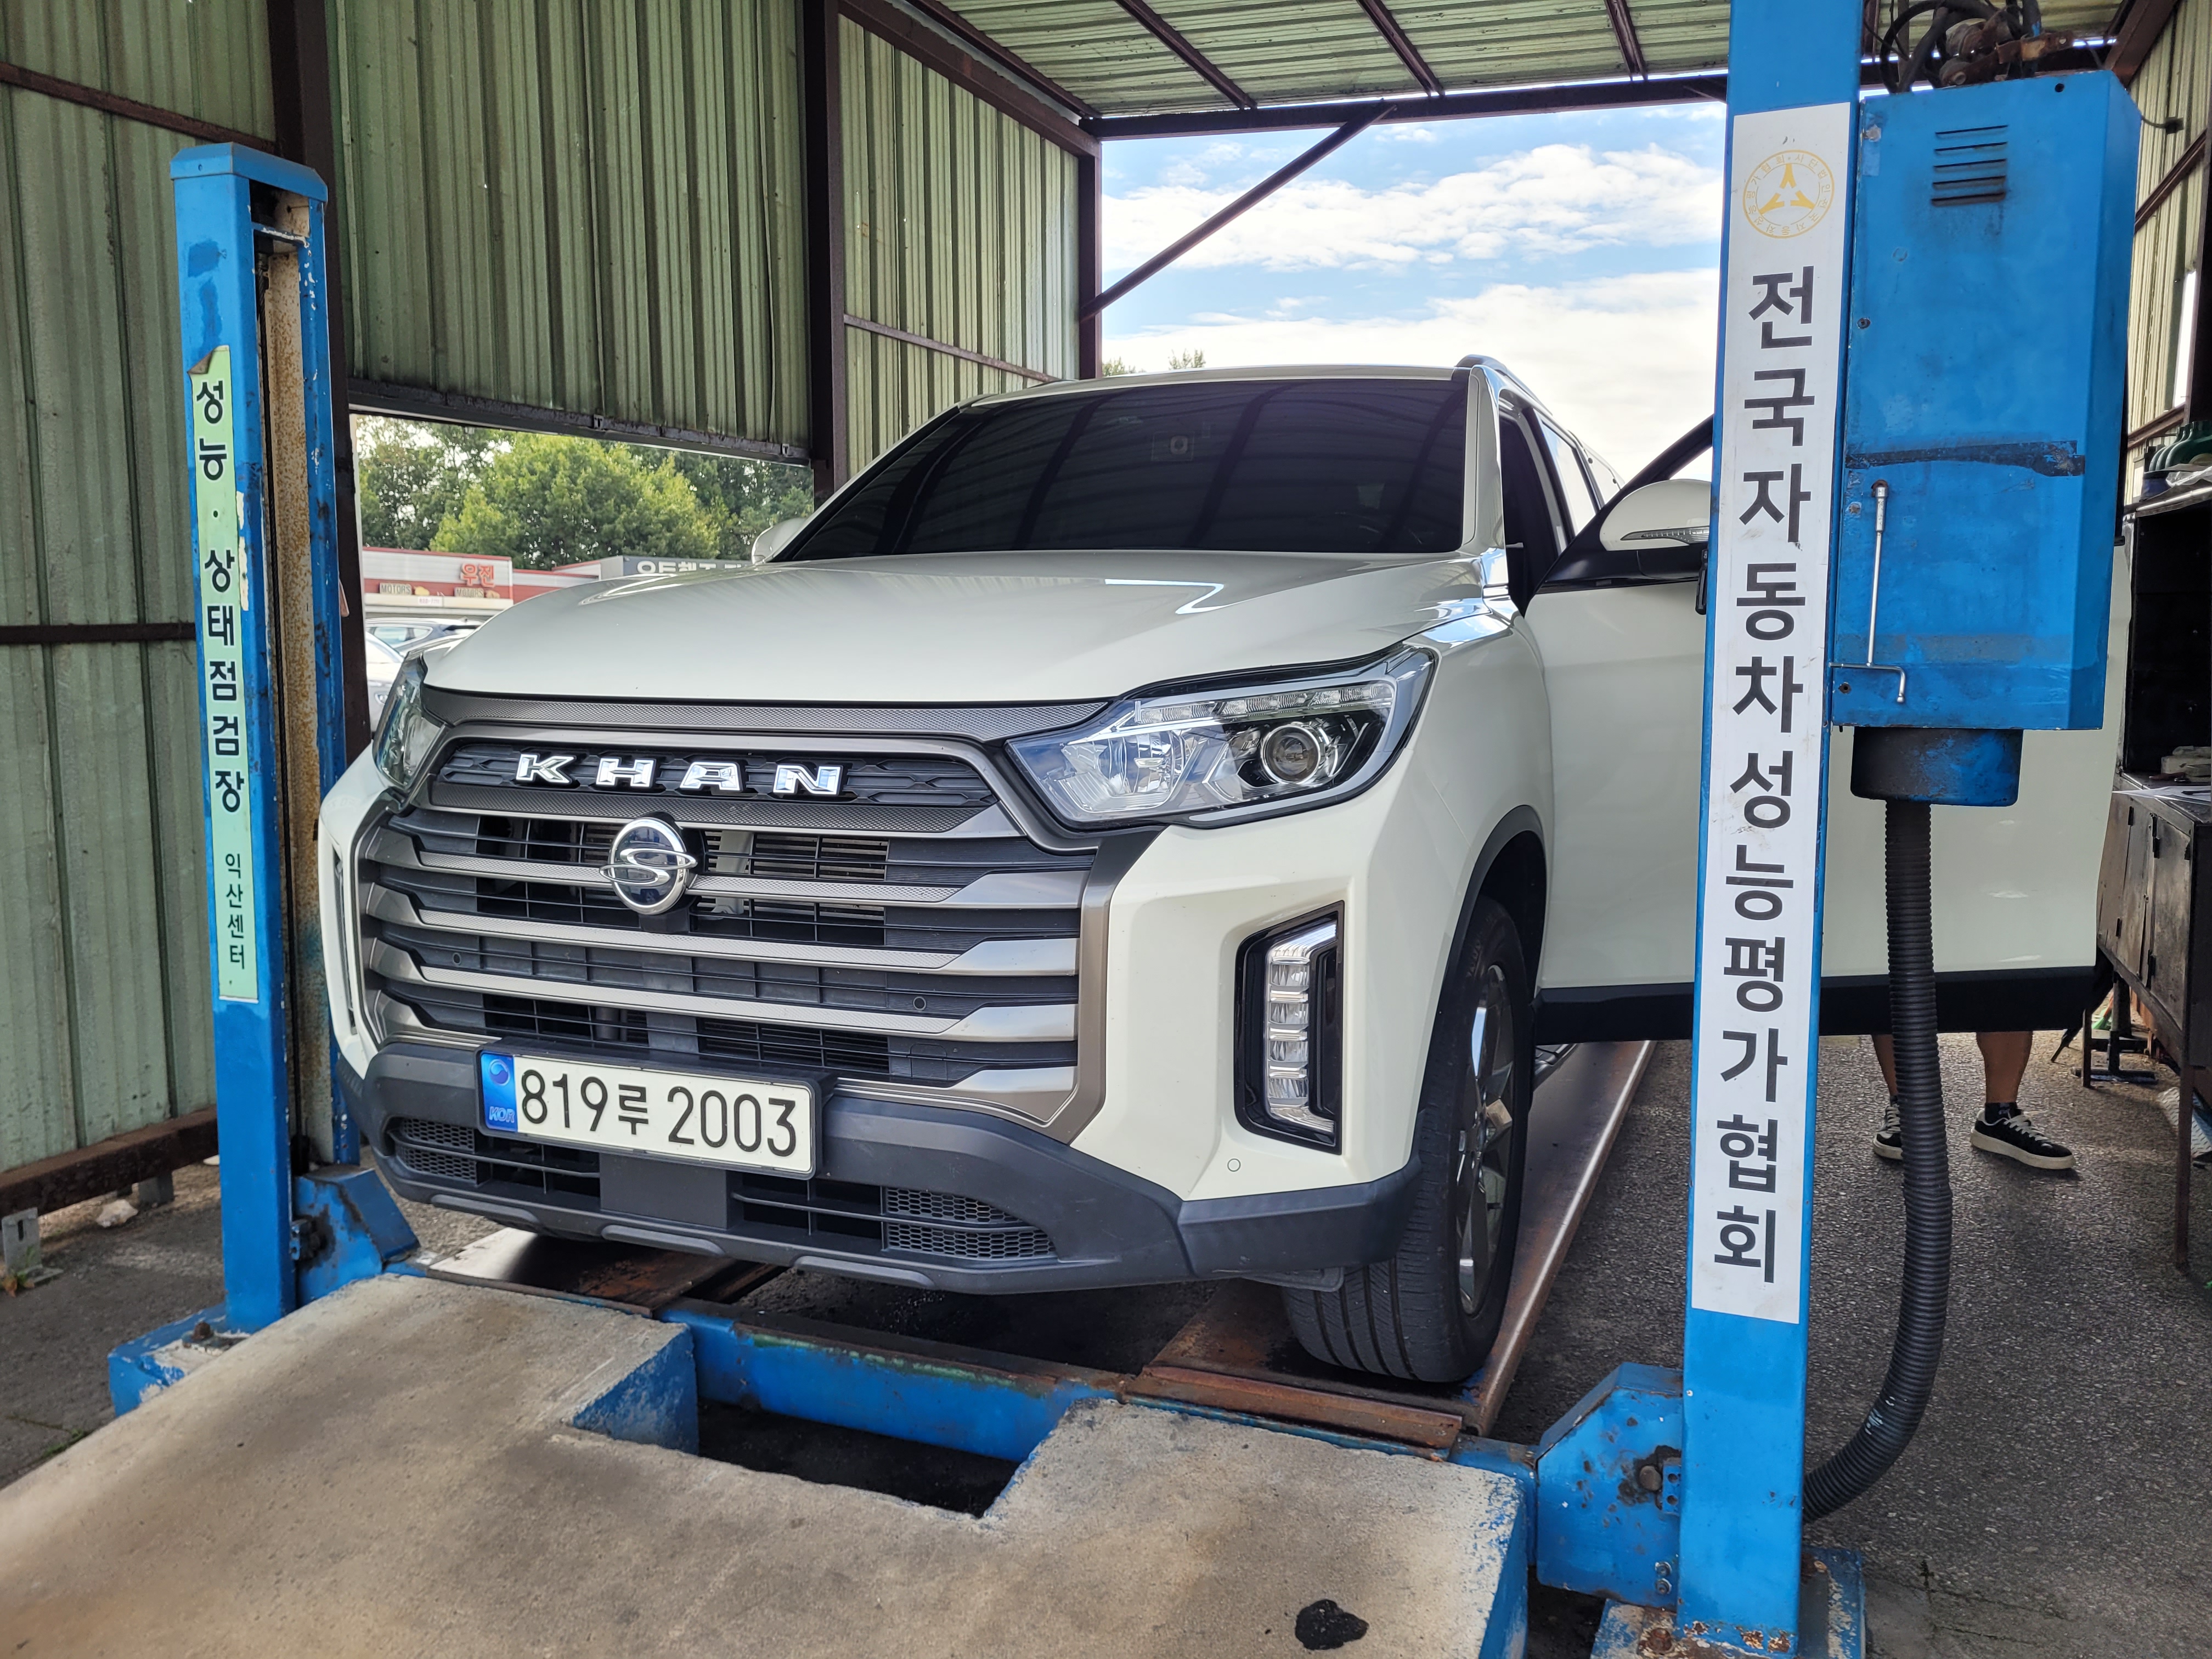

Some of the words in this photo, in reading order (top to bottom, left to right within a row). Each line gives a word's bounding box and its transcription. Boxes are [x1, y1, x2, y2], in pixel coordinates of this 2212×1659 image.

[381, 584, 411, 595] MOTORS
[515, 753, 843, 795] KHAN
[1714, 266, 1815, 1284] 전국자동차성능평가협회
[225, 853, 245, 970] 익산센터
[489, 1105, 515, 1124] KOR
[521, 1069, 649, 1135] 819루
[667, 1086, 797, 1157] 2003
